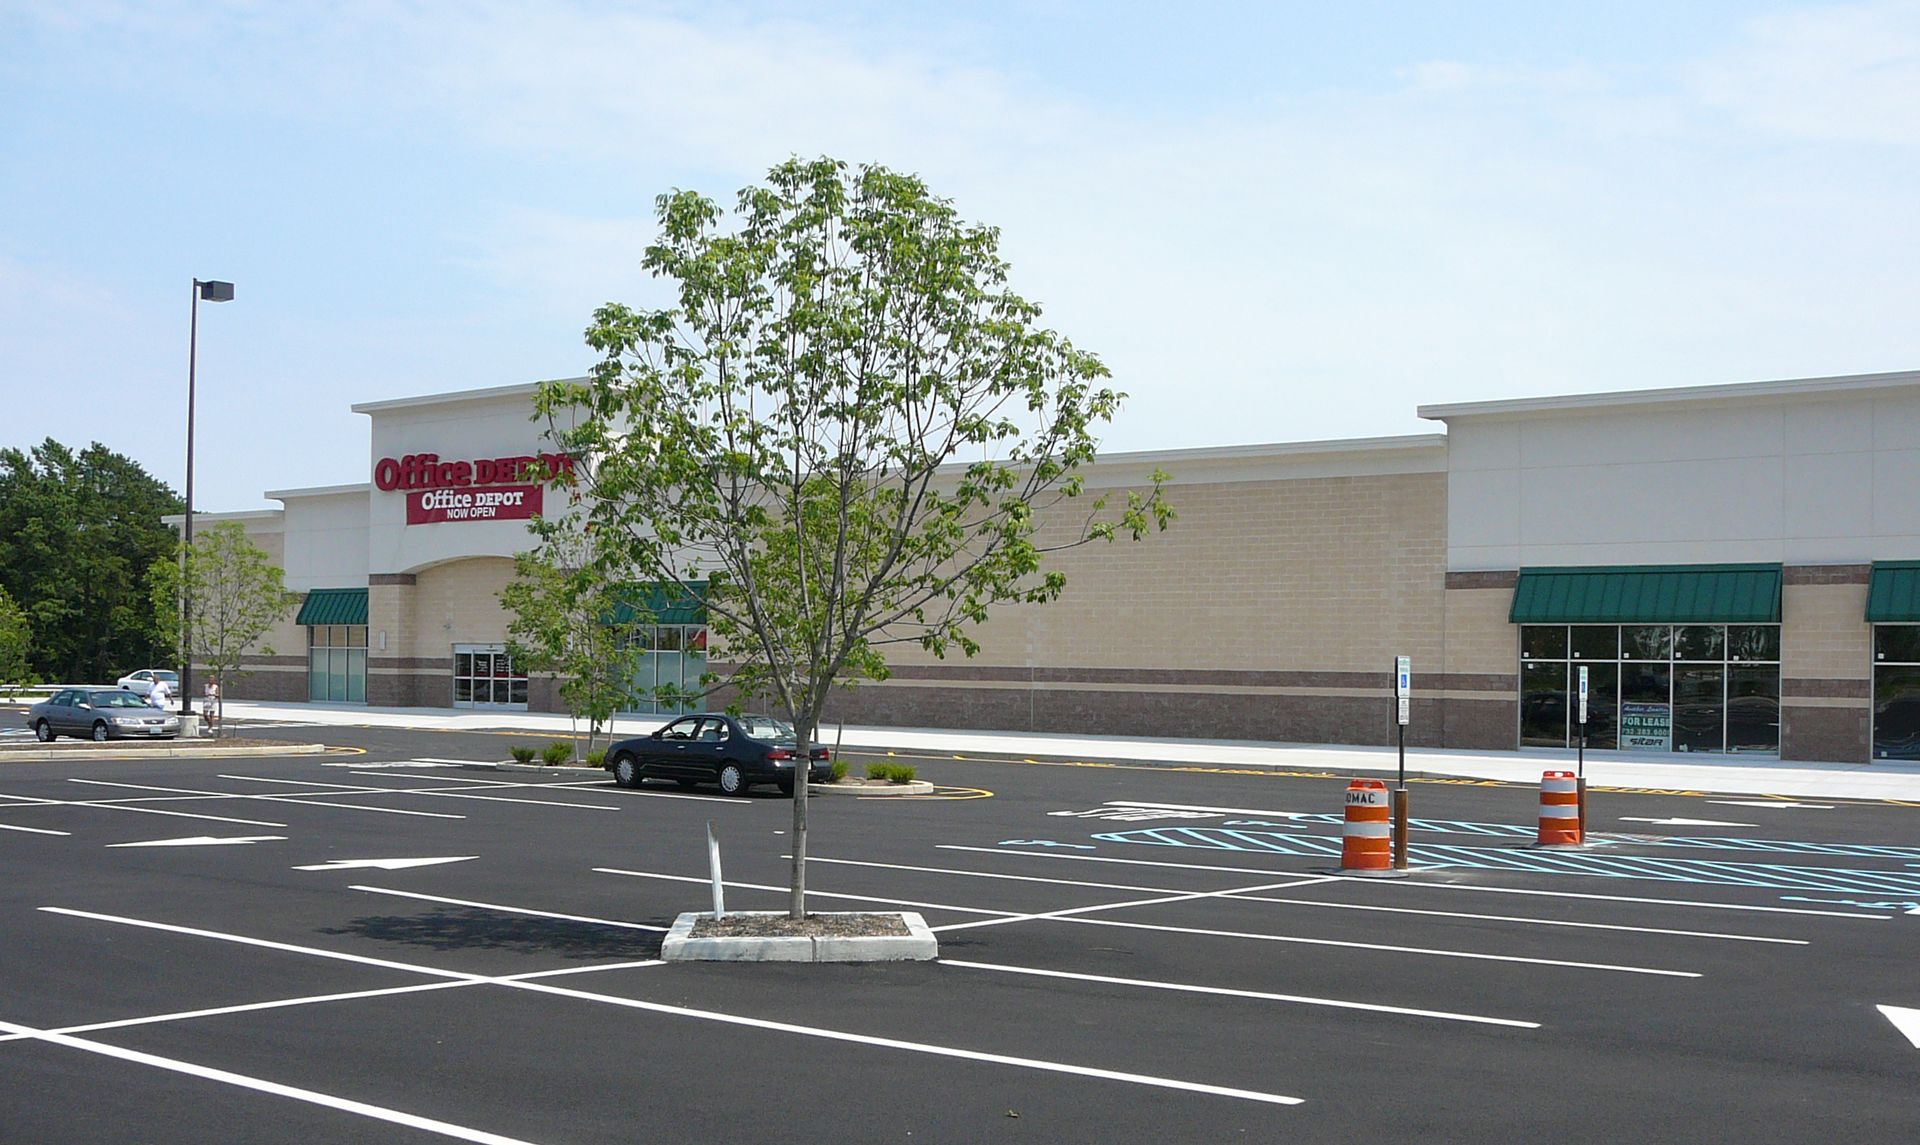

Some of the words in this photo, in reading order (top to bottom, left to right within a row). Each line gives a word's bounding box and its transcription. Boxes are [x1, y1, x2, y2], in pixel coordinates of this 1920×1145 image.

[374, 453, 471, 491] Office
[473, 453, 577, 486] DEPOT
[421, 490, 472, 509] Office
[475, 491, 523, 506] DEPOT
[447, 508, 468, 519] NOW
[470, 507, 495, 518] OPEN
[1622, 717, 1640, 726] FOR
[1642, 718, 1670, 727] LEASE
